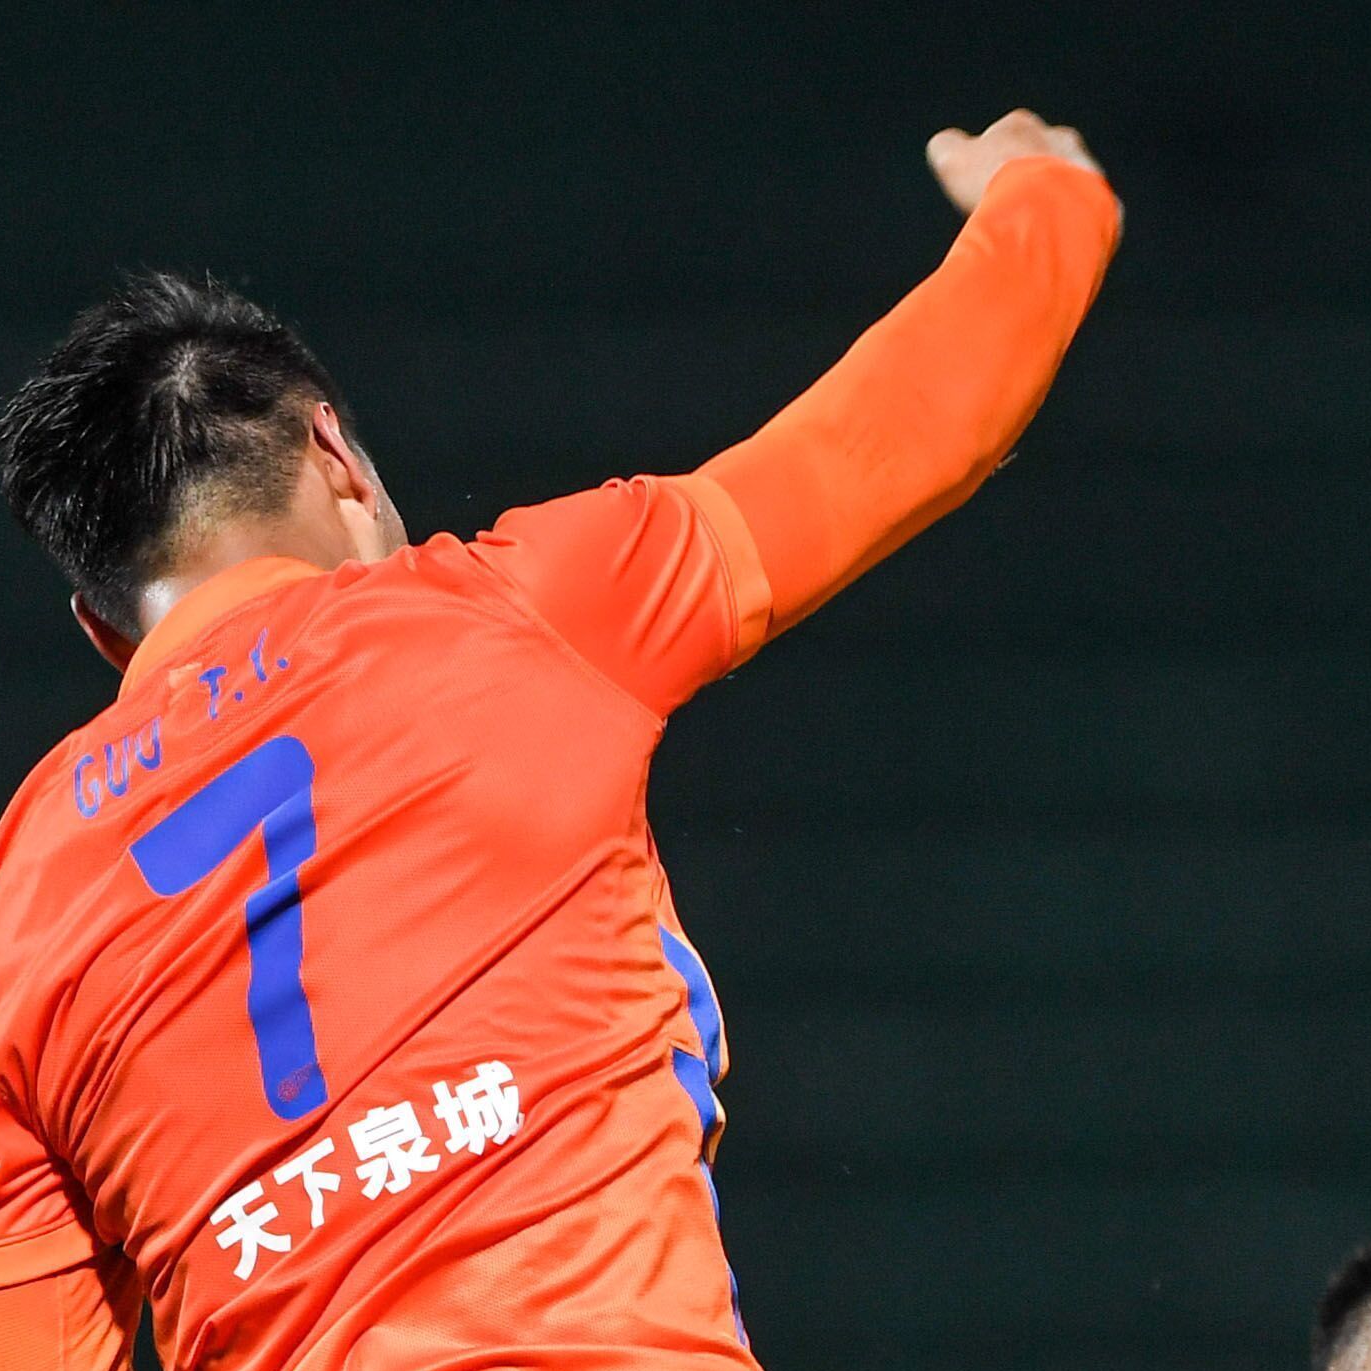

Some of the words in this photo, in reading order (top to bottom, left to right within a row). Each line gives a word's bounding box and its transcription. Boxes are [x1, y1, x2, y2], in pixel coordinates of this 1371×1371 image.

[129, 735, 329, 1121] 7
[209, 1060, 525, 1281] 天下泉城
